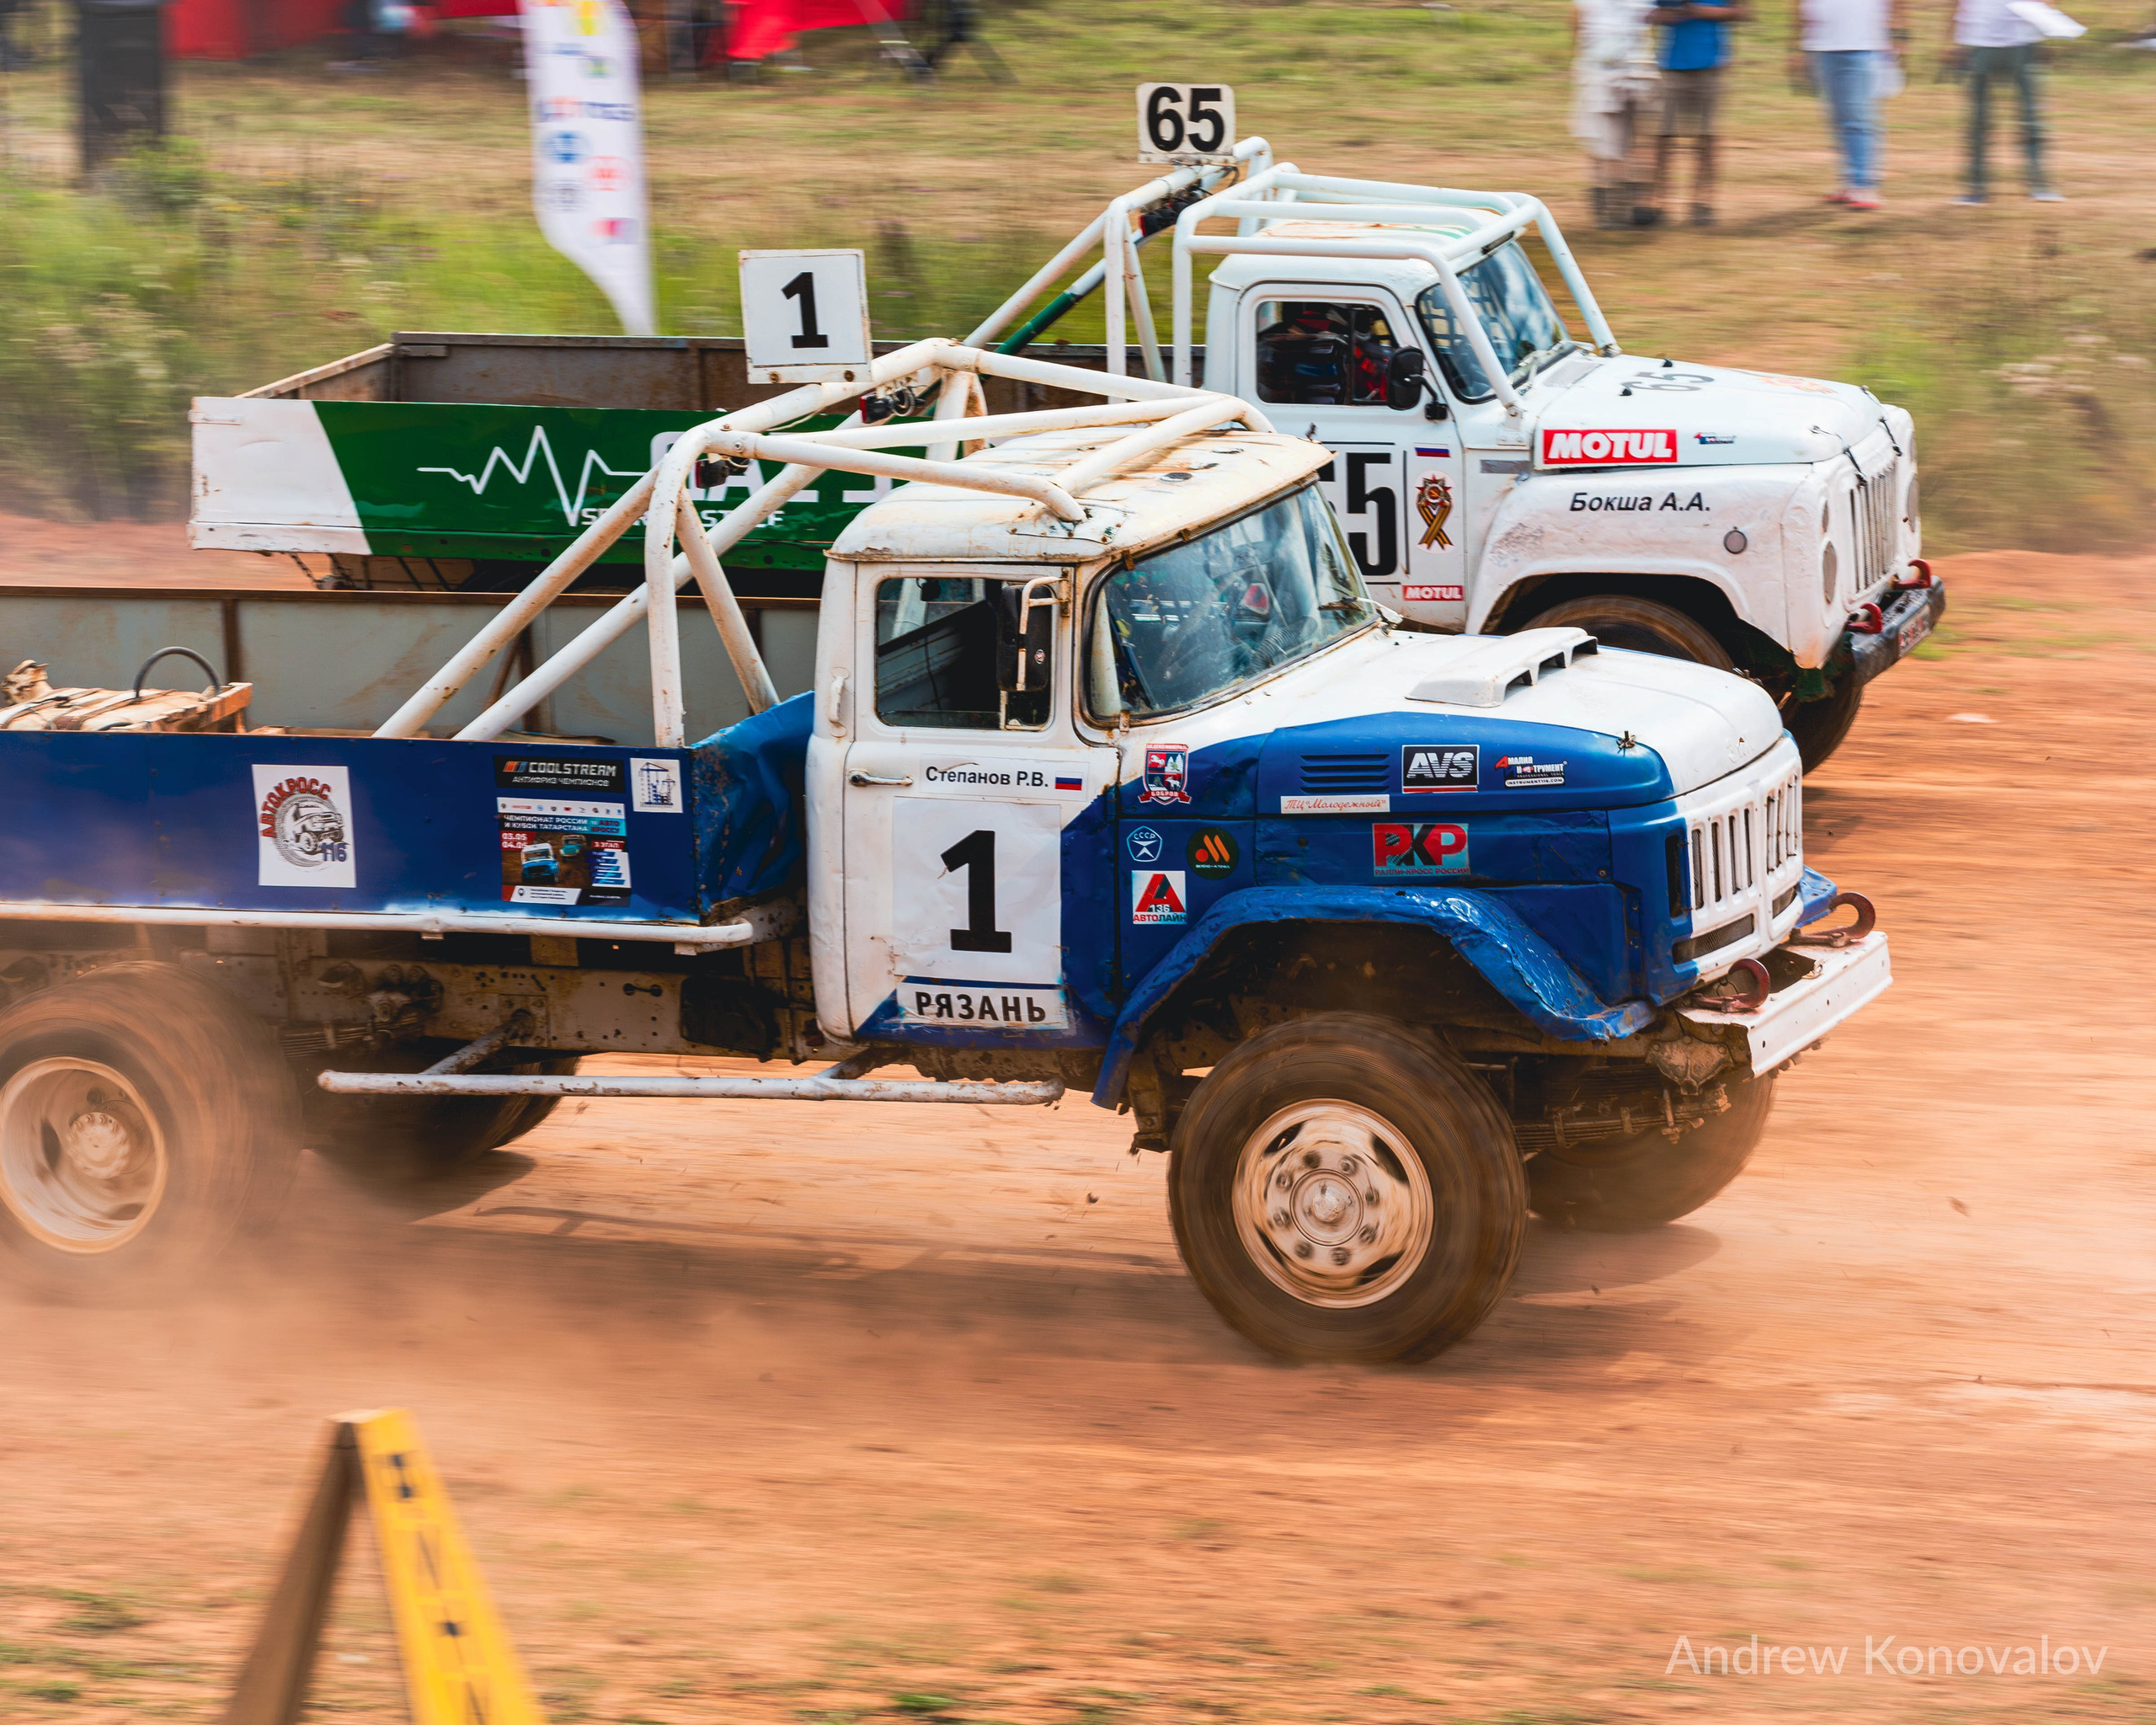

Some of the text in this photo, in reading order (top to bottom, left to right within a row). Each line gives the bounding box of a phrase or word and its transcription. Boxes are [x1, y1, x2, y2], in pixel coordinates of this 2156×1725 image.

[1148, 86, 1225, 152] 65
[781, 271, 829, 349] 1
[1548, 432, 1673, 460] MOTUL
[1569, 491, 1711, 512] Бокша А.А.
[1316, 451, 1397, 576] 5
[1405, 586, 1463, 601] MOTUL
[528, 761, 616, 777] COOLSTREAM
[1406, 751, 1475, 779] AVS
[512, 776, 611, 787] АНТИФРИЗ ЧЕМПИОНОВ
[926, 766, 1049, 788] Степанов Р.В.
[259, 777, 332, 838] АВТОКРОСС
[504, 814, 554, 824] ЧЕМПИОНАТ
[501, 832, 528, 841] 03.05
[1134, 831, 1156, 841] СССР
[321, 842, 347, 862] 116
[1374, 868, 1433, 876] РАЛЛИ-КРОСС
[941, 830, 1012, 953] 1
[1133, 913, 1187, 922] АВТОЛАЙН
[1149, 904, 1171, 912] 136
[915, 991, 1046, 1023] РЯЗАНЬ
